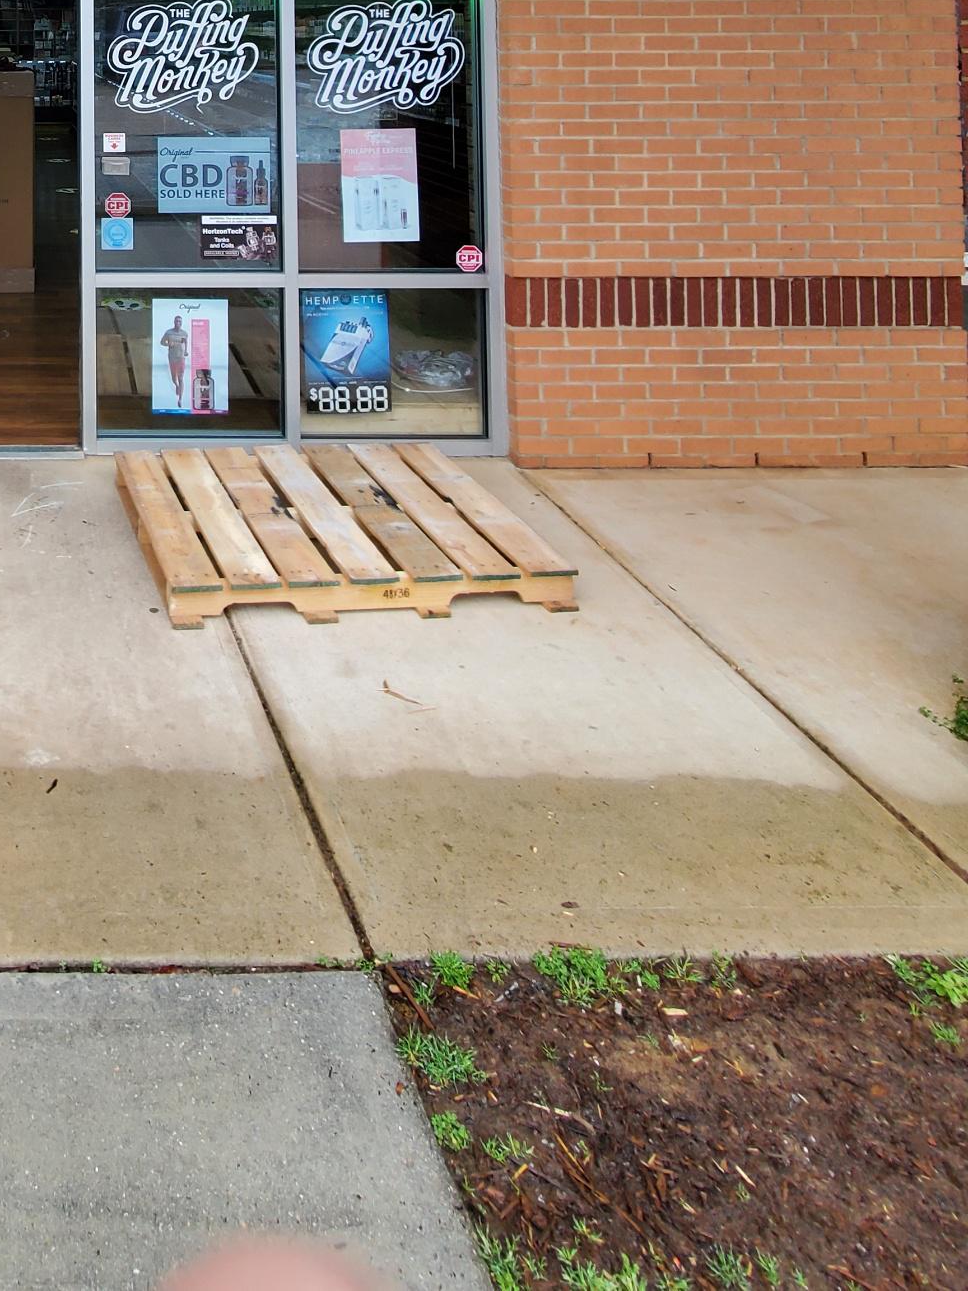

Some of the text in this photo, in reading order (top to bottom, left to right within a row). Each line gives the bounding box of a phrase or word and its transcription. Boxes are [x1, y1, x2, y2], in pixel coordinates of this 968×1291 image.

[169, 8, 191, 18] THE
[369, 9, 390, 18] THE
[123, 0, 250, 68] Puffing
[323, 0, 450, 68] Puffing
[112, 38, 260, 108] Monkey
[312, 38, 460, 108] Monkey
[160, 147, 193, 162] Original
[160, 164, 223, 188] CBD
[160, 189, 225, 199] SOLD HERE
[107, 201, 129, 210] CPI
[458, 254, 480, 262] CPI
